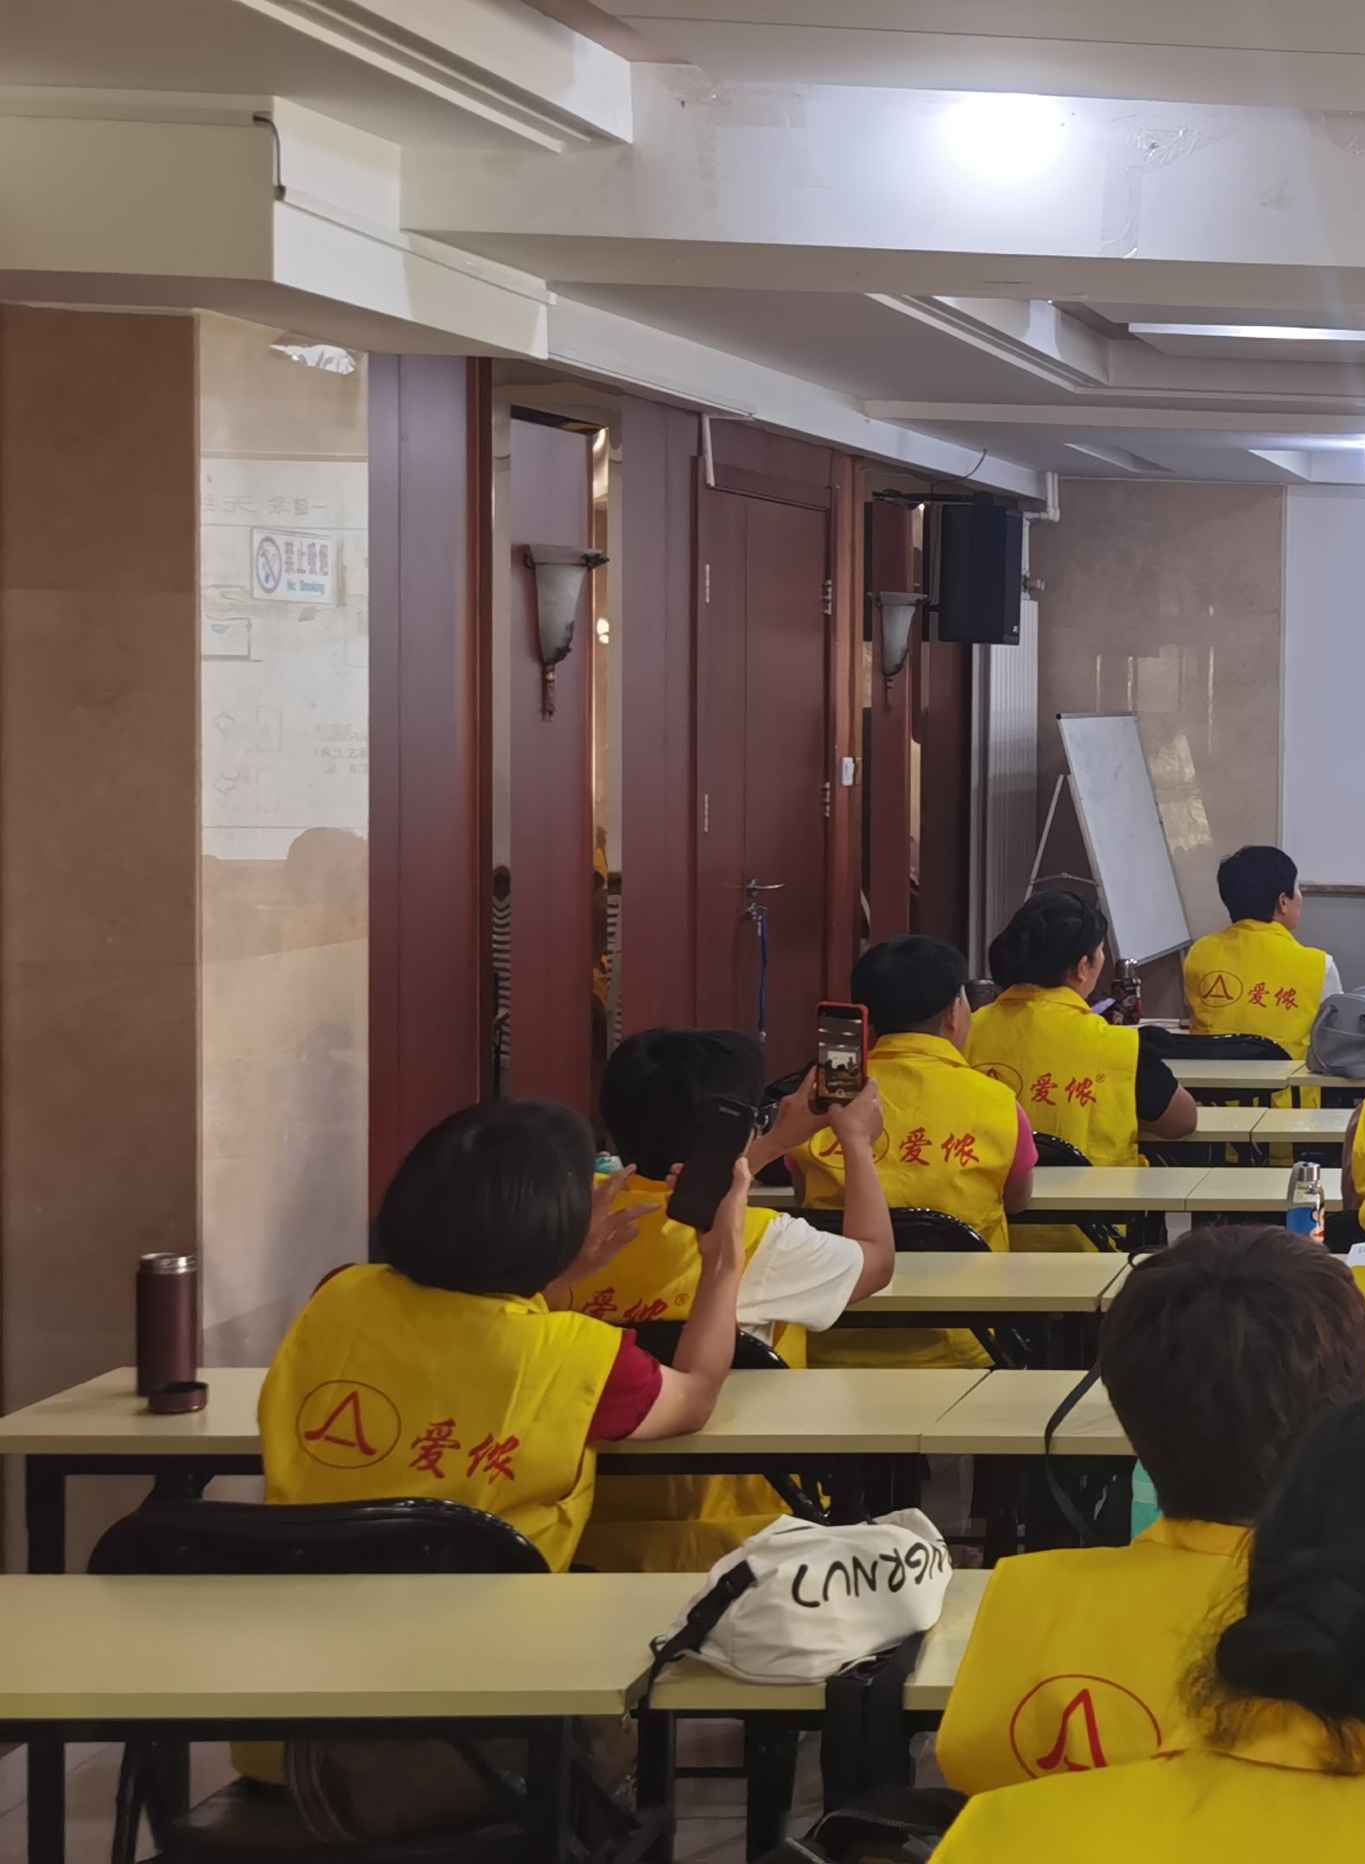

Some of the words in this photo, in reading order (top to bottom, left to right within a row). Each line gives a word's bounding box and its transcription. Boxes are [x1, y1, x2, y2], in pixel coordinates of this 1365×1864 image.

[284, 540, 329, 577] 禁止吸烟
[1248, 984, 1299, 1011] 爱侬
[1030, 1075, 1097, 1107] 爱侬
[899, 1129, 979, 1168] 爱侬
[409, 1418, 520, 1486] 爱侬
